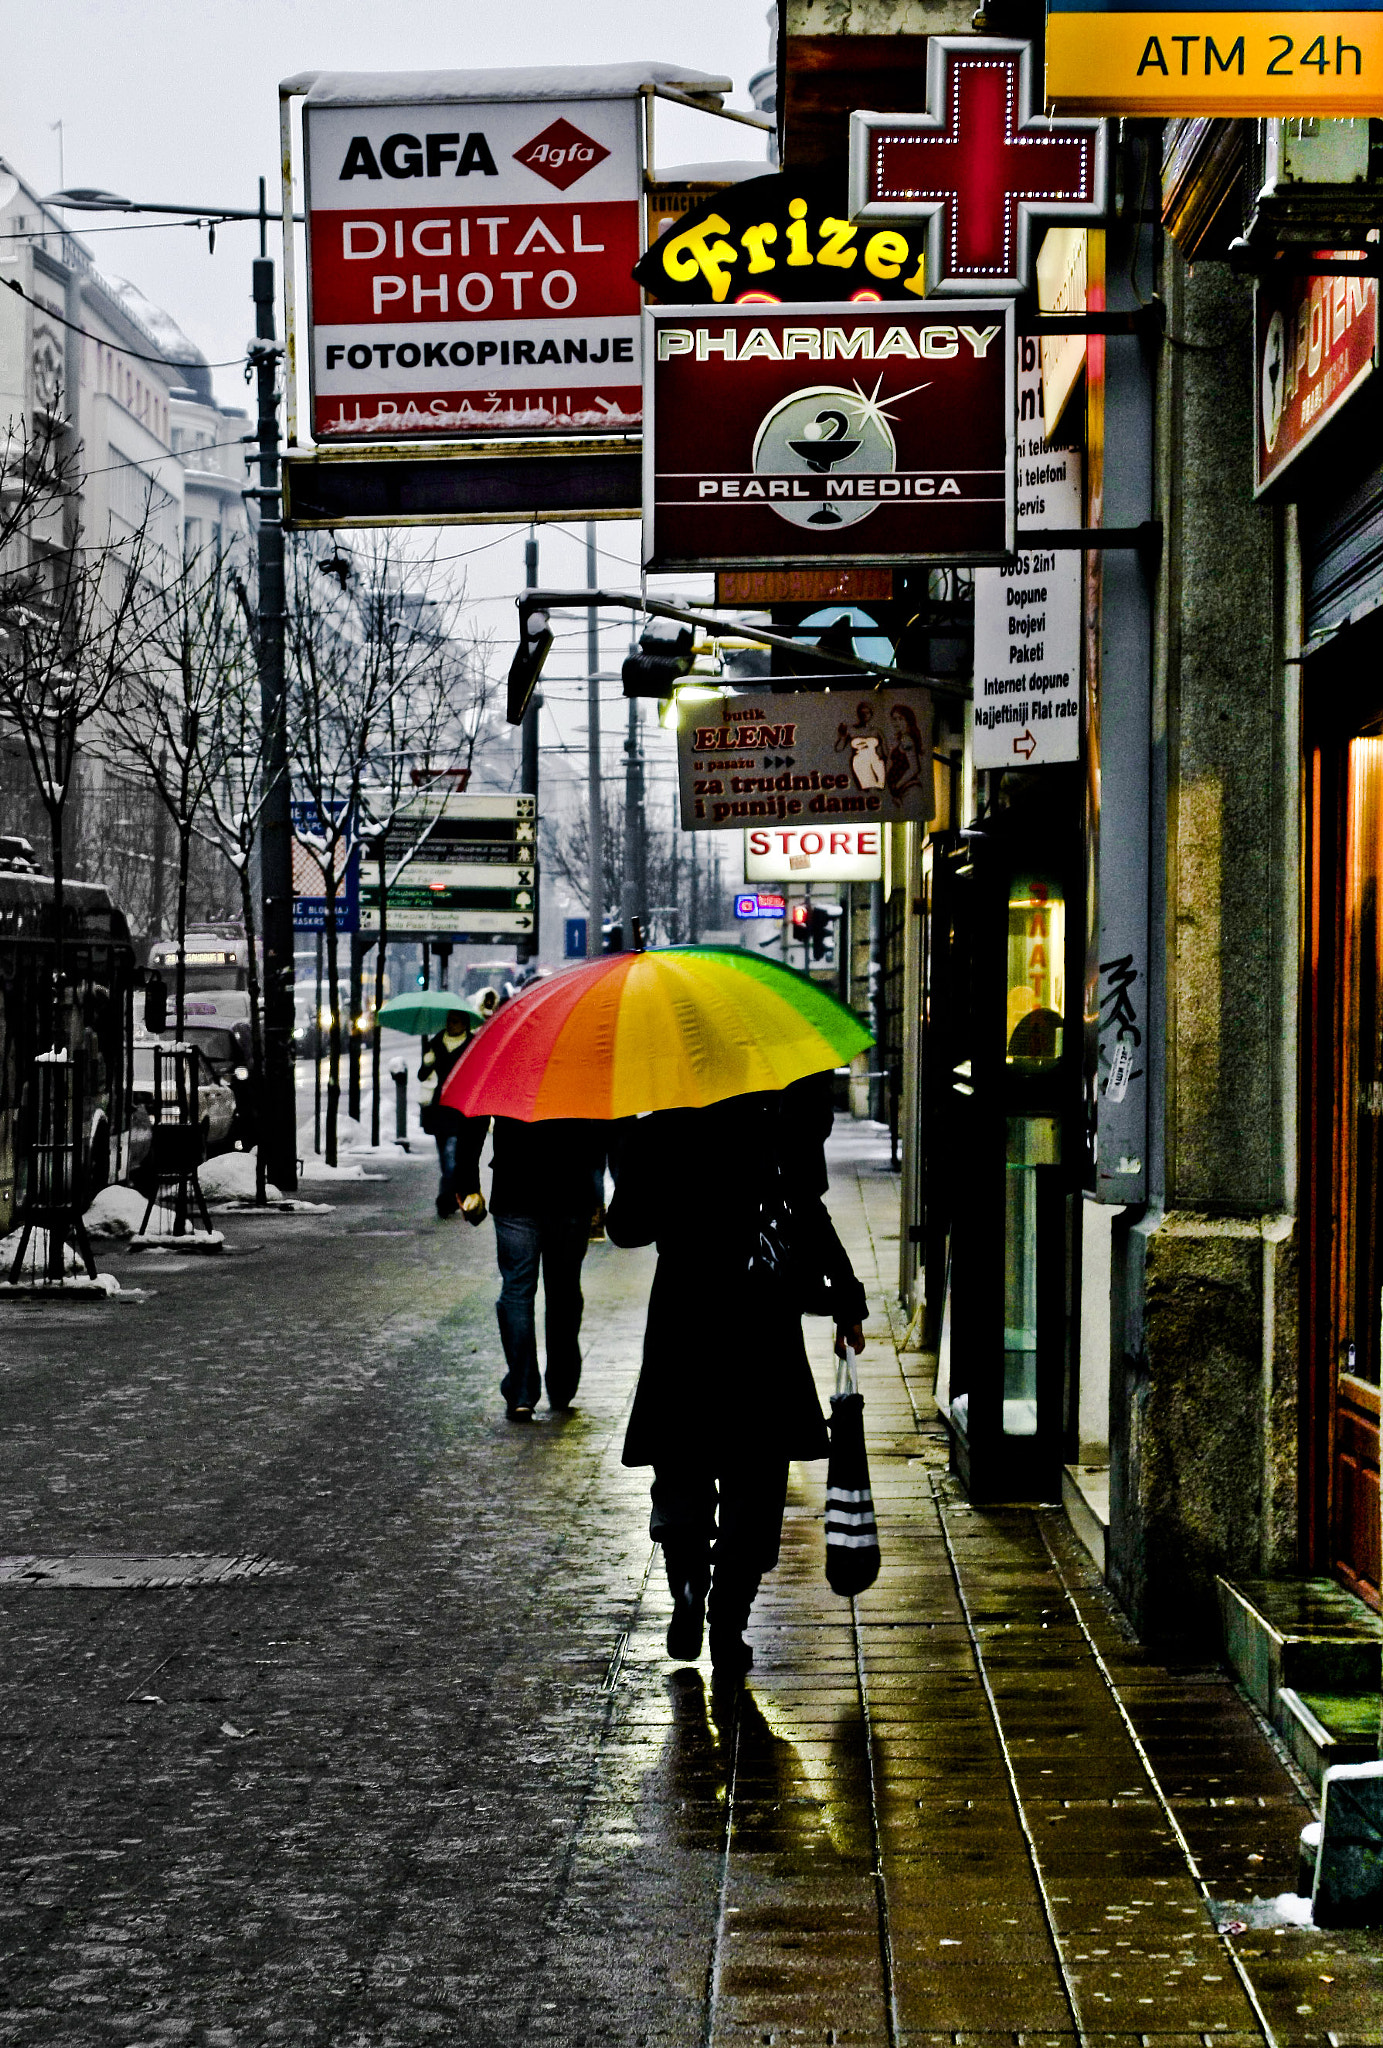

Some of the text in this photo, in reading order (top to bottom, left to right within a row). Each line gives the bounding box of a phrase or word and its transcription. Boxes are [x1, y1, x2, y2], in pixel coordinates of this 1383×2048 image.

[1136, 34, 1362, 76] ATM 24h
[338, 132, 499, 181] AGFA
[526, 142, 595, 168] Agfa
[342, 214, 605, 260] DIGITAL
[373, 269, 578, 315] PHOTO
[325, 337, 634, 370] FOTOKOPIRANJE
[657, 325, 1002, 361] PHARMACY
[1026, 461, 1067, 487] telefoni
[698, 478, 961, 498] PEARL MEDICA
[1033, 552, 1056, 573] 2in1
[1006, 586, 1048, 610] Dopune
[1008, 613, 1046, 638] Brojevi
[1009, 642, 1044, 664] Paketi
[984, 671, 1070, 696] Internet dopune
[722, 708, 766, 722] butik
[975, 699, 1078, 730] Najjeftiniji Flat rate
[694, 723, 798, 751] ELENI
[693, 761, 704, 771] u
[694, 771, 849, 795] za trudnice
[695, 793, 881, 821] i punije dame
[749, 830, 878, 856] STORE
[292, 917, 345, 926] RASKRSU
